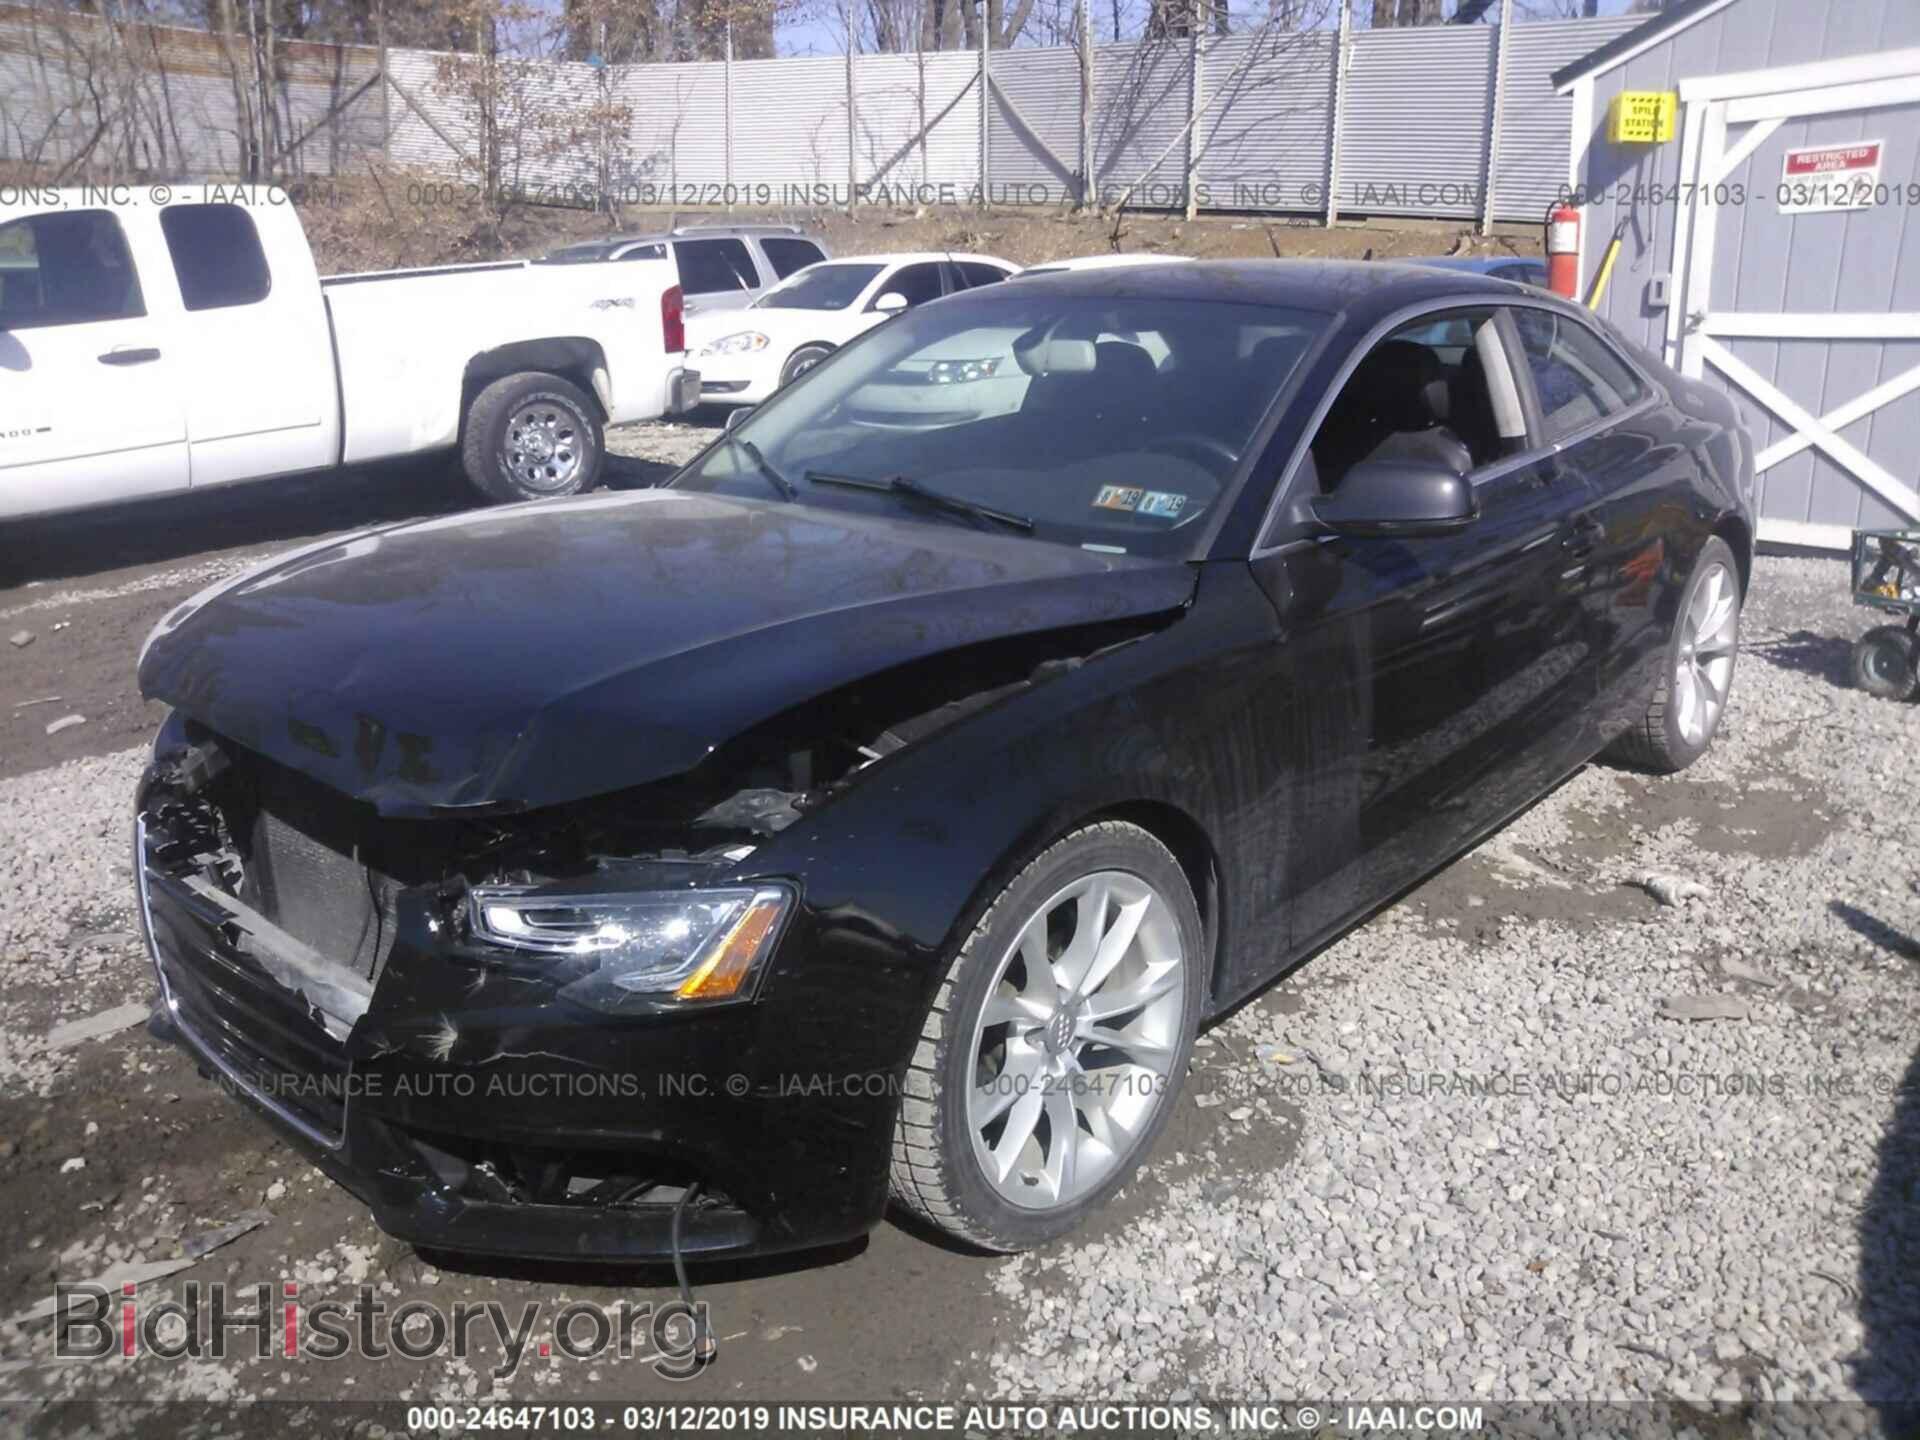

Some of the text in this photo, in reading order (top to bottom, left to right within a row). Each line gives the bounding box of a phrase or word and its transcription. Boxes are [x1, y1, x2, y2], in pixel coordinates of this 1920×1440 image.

[1796, 148, 1869, 164] RESTRICTED
[1814, 160, 1847, 172] AREA
[1166, 496, 1185, 512] 19
